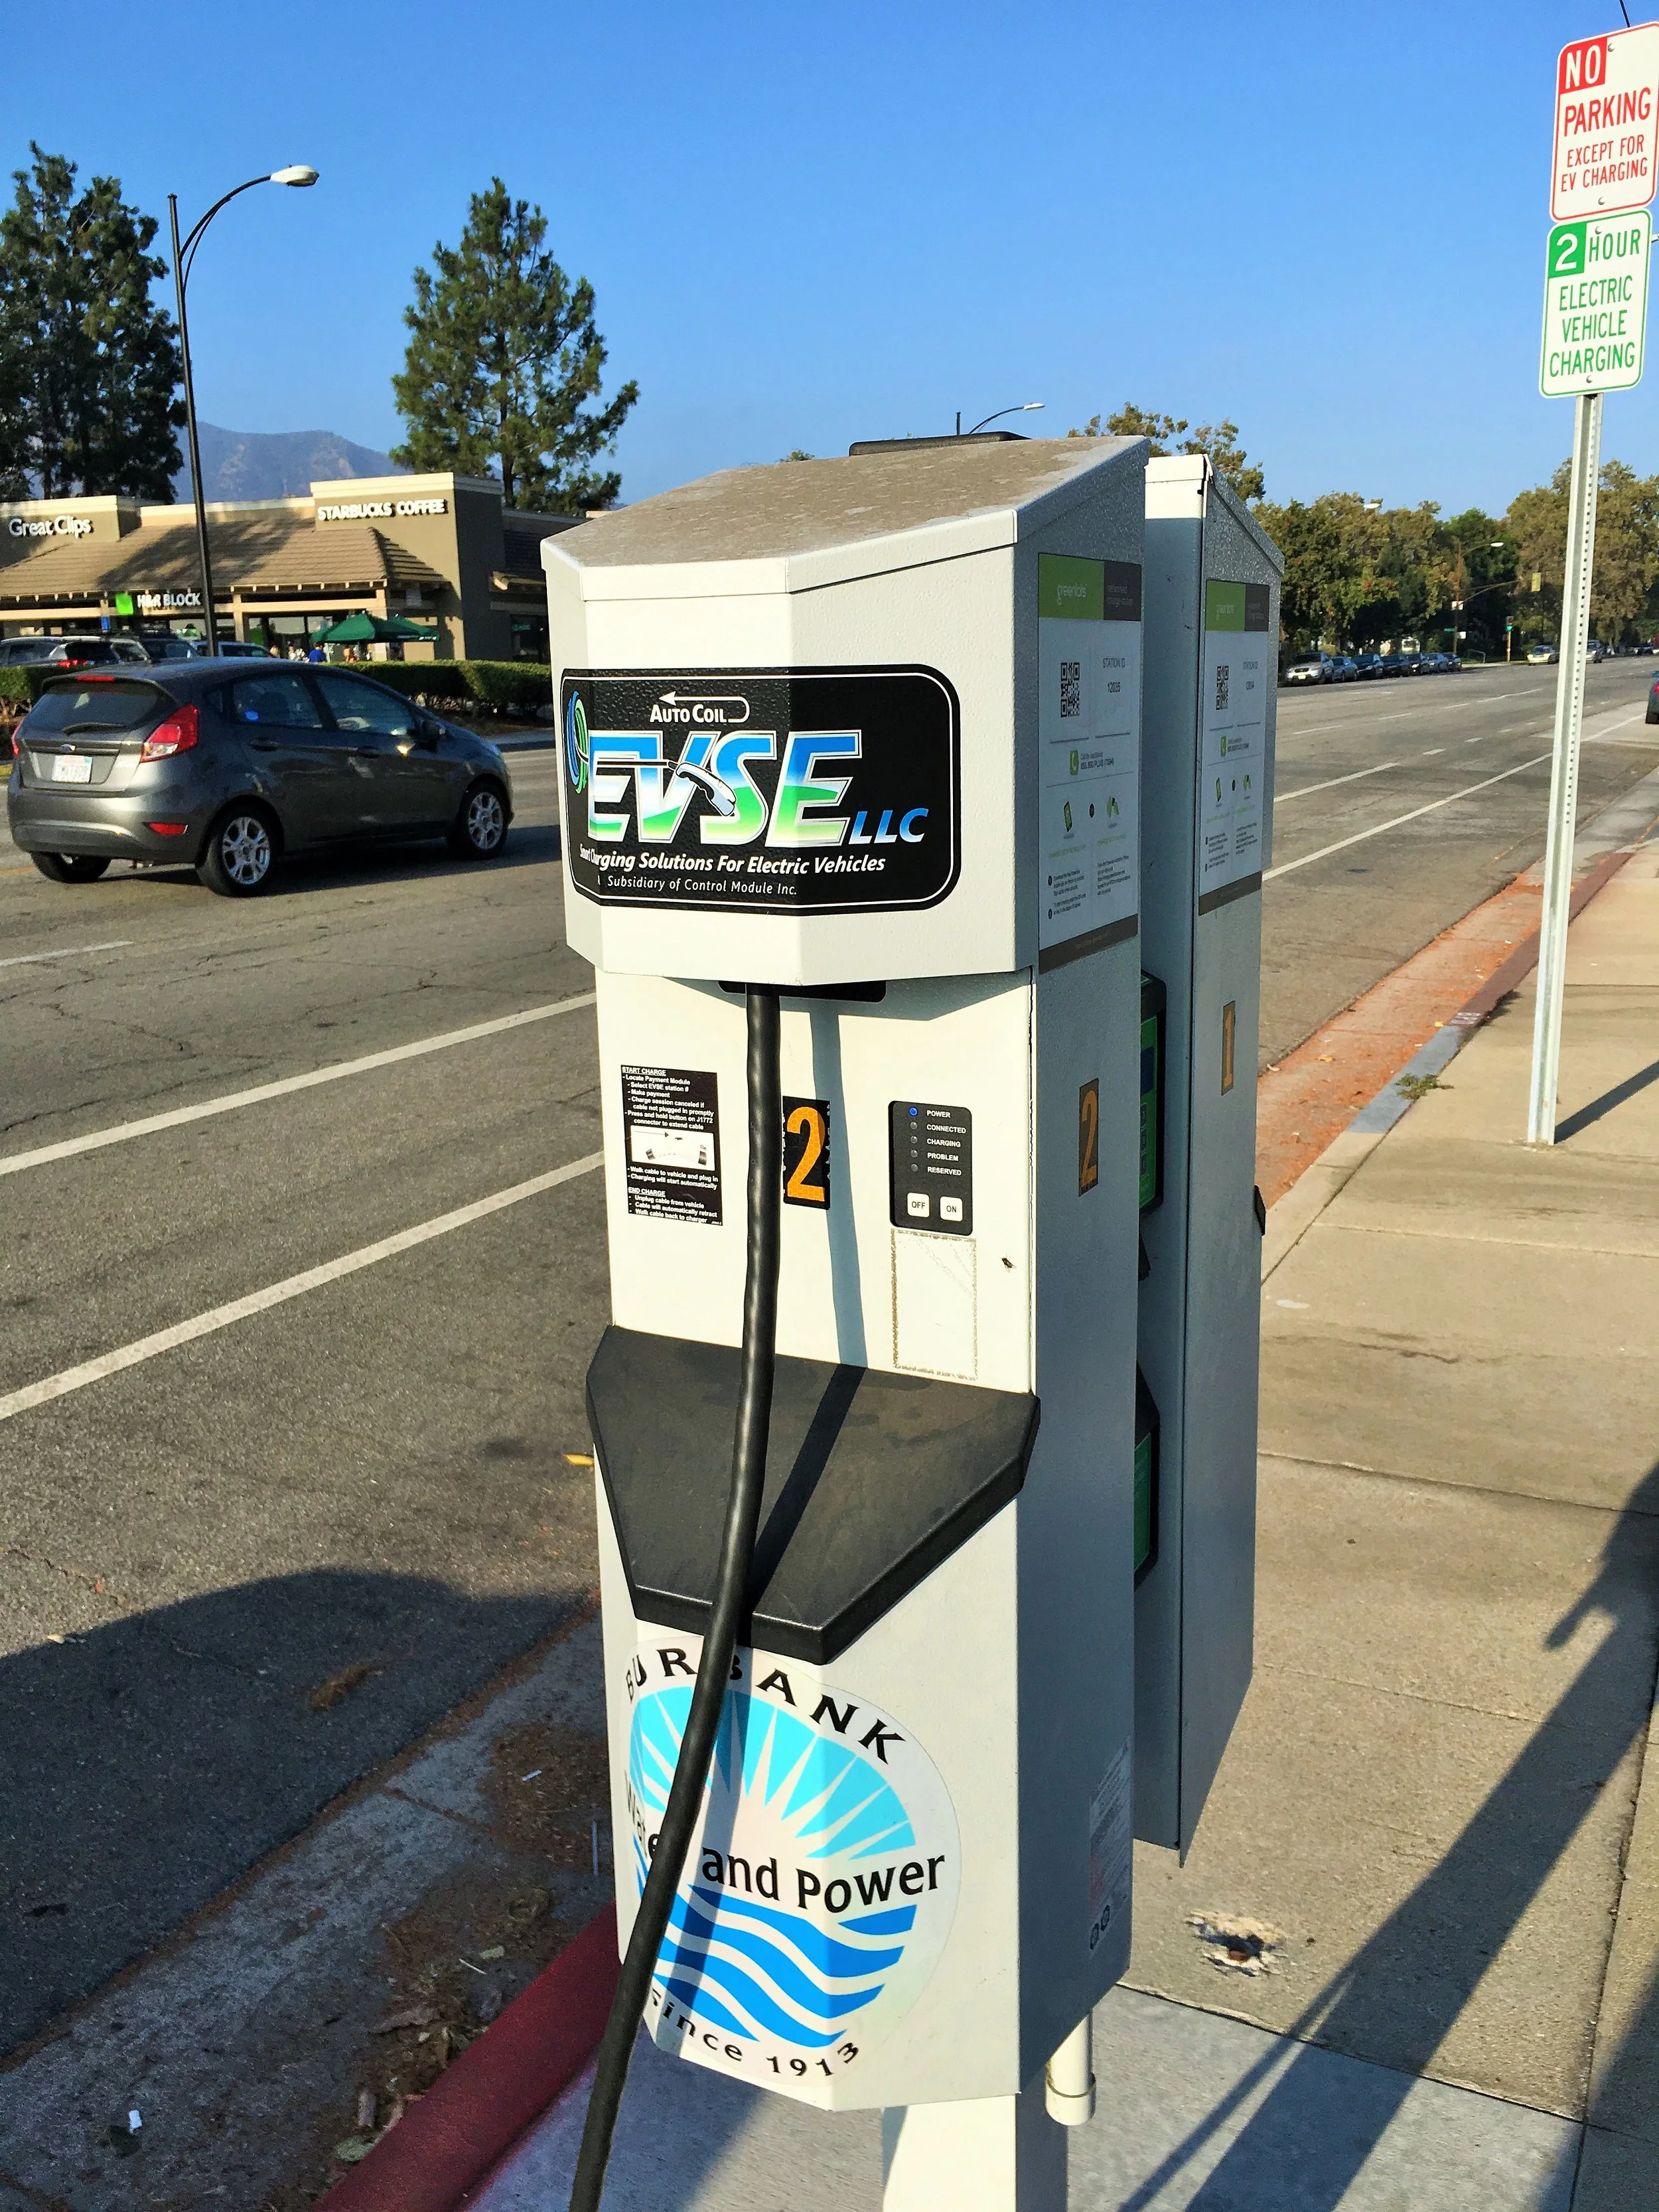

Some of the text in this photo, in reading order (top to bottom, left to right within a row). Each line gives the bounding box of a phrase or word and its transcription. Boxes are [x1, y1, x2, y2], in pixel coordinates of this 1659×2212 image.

[1565, 44, 1601, 89] NO
[1563, 87, 1650, 137] PARKING
[1567, 134, 1644, 167] EXCEPT FOR
[1561, 157, 1648, 192] EV CHARGING
[1555, 229, 1640, 271] 2 HOUR
[1559, 275, 1632, 311] ELECTRIC
[1562, 309, 1626, 343] VEHICLE
[1550, 342, 1635, 378] CHARGING
[318, 498, 445, 520] STARBUCKS COFFEE
[9, 515, 92, 539] Great Clips
[137, 593, 200, 608] H&R BLOCK
[588, 729, 862, 848] EVSE
[849, 808, 929, 845] LLC
[591, 848, 636, 872] Charging
[638, 852, 713, 871] Solutions
[717, 855, 743, 873] For
[748, 855, 809, 874] Electric
[814, 855, 885, 873] Vehicles
[607, 875, 665, 891] Subsidiary
[669, 878, 681, 891] of
[684, 878, 727, 893] Control
[731, 880, 772, 894] Module
[777, 883, 798, 895] Inc.
[926, 1110, 950, 1118] POWER
[926, 1124, 966, 1134] CONNECTED
[926, 1138, 961, 1147] CHARGING
[1082, 1090, 1097, 1188] 2
[786, 1106, 825, 1202] 2
[927, 1152, 959, 1161] PROBLEM
[630, 1173, 656, 1183] Charging
[680, 1179, 717, 1190] automatically
[927, 1166, 962, 1176] RESERVED
[634, 1195, 654, 1203] Unplug
[662, 1205, 698, 1216] automatically
[946, 1205, 957, 1213] ON
[624, 1769, 946, 1913] Wate and Power
[766, 2042, 859, 2077] 1913
